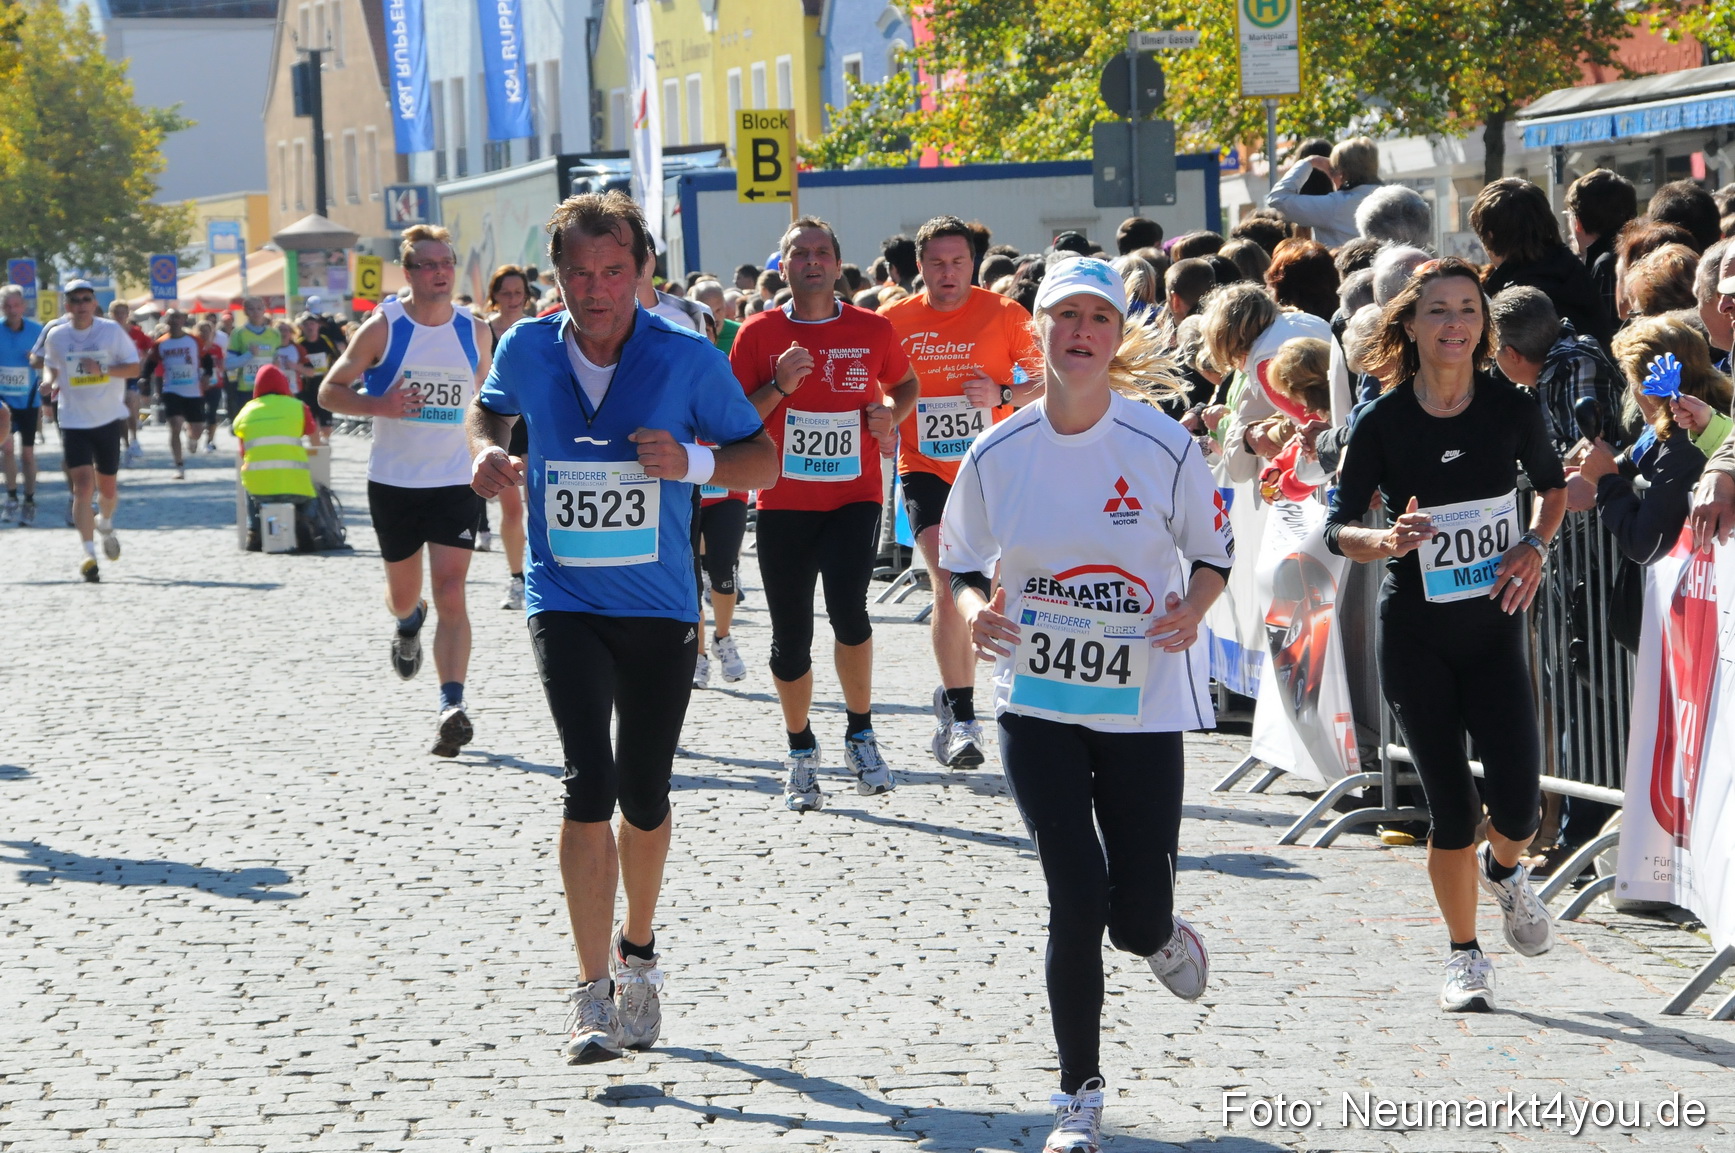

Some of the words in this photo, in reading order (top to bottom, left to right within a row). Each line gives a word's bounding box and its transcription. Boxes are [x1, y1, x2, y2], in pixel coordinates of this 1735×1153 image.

[497, 0, 518, 60] RUPP
[1248, 33, 1288, 41] Marktplatz
[1140, 35, 1165, 45] Ulmer
[1168, 33, 1195, 44] Gasse
[742, 113, 789, 130] Block
[752, 137, 782, 182] B
[361, 269, 376, 290] C
[43, 300, 53, 316] D
[911, 341, 975, 354] Fischer
[917, 353, 971, 361] AUTOMOBILE
[927, 366, 941, 374] und
[926, 401, 958, 410] PFLEIDERER
[409, 406, 457, 421] ichael
[796, 416, 830, 425] PFLEIDERER
[925, 411, 985, 440] 2354
[791, 429, 852, 457] 3208
[1445, 450, 1461, 458] RUN
[804, 458, 840, 472] Peter
[559, 470, 608, 481] PFLEIDERER
[556, 488, 647, 529] 3523
[1431, 509, 1481, 524] PFLEIDERER
[1431, 518, 1510, 568] 2080
[1023, 577, 1126, 602] GERHART
[1126, 586, 1138, 598] &
[1037, 611, 1092, 630] PFLEIDERER
[1036, 622, 1091, 636] AKTIENGESELLSCHAFT
[1028, 632, 1132, 685] 3494
[1653, 856, 1672, 867] Für
